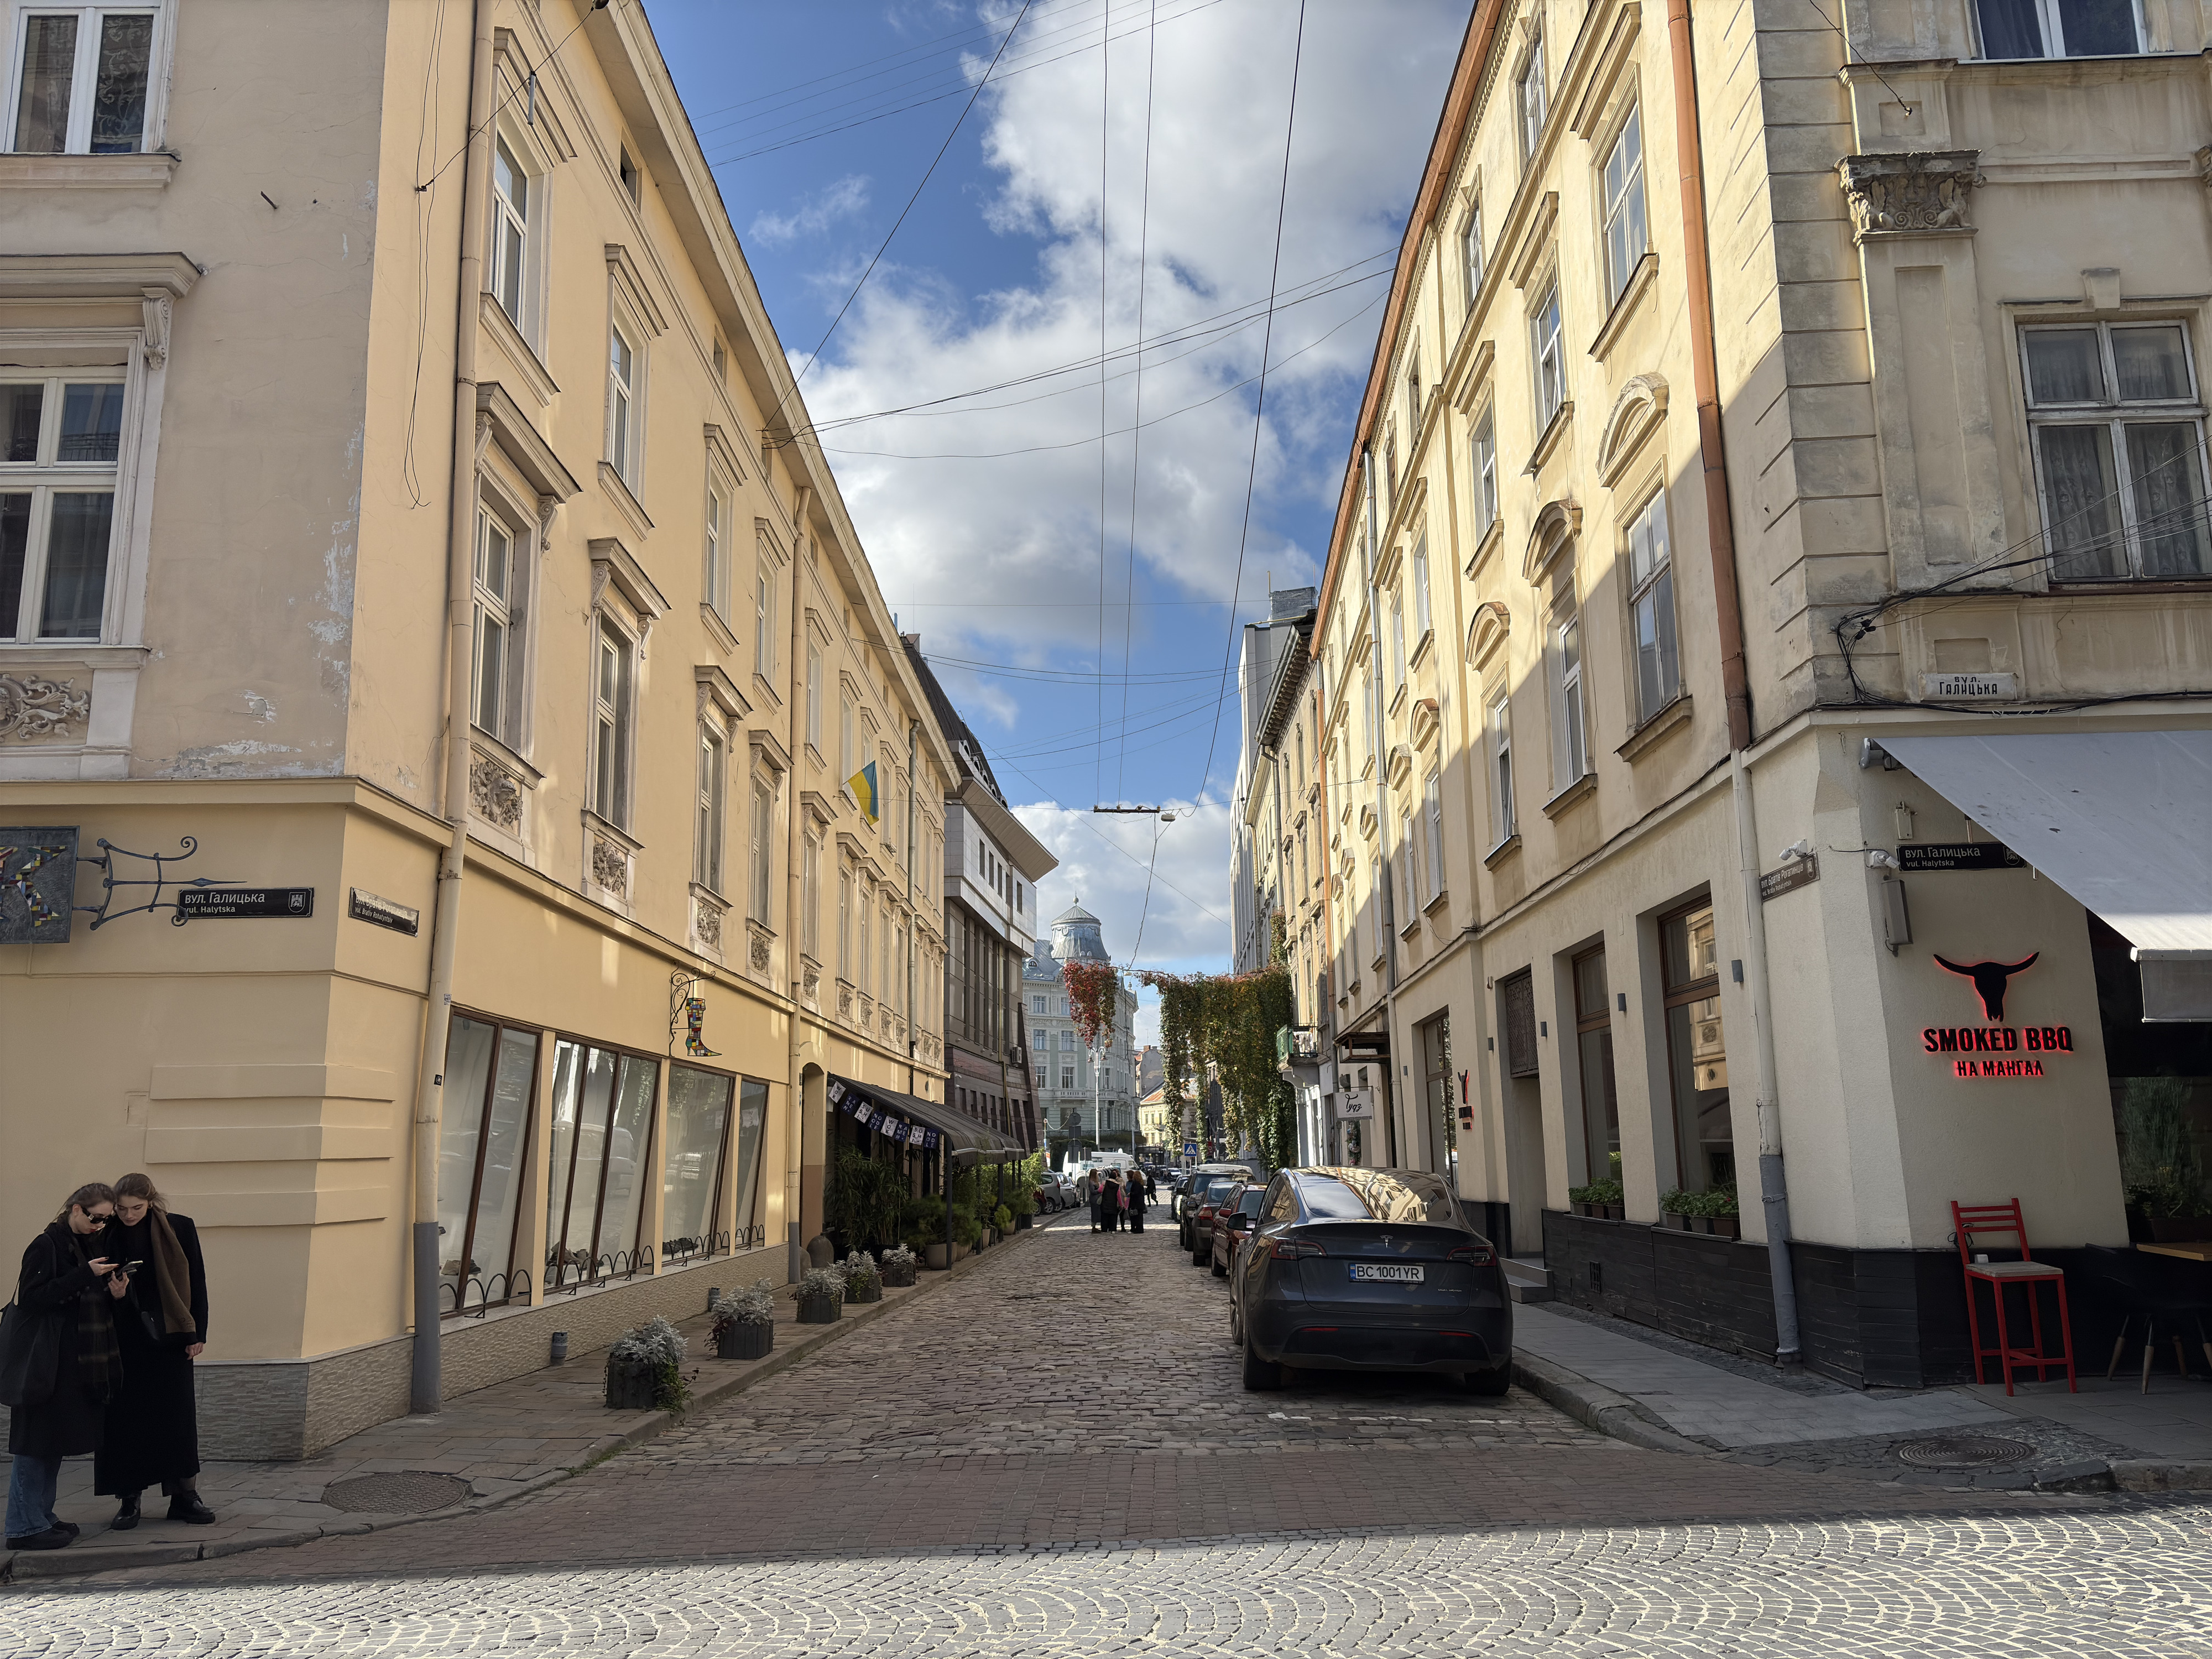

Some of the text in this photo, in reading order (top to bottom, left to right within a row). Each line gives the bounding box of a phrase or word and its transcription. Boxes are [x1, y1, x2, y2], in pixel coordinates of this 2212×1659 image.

[1905, 847, 1981, 858] вул. Галицька
[1768, 872, 1781, 886] Братів
[1781, 862, 1803, 880] Рогатинців
[185, 892, 265, 905] вул. Галицька
[201, 906, 236, 914] Halytska
[362, 907, 373, 917] Brativ
[1923, 1026, 2074, 1052] SMOKED BBQ
[1957, 1060, 2044, 1076] НА МАНГАЛ
[1357, 1266, 1420, 1280] BC 1001 YR
